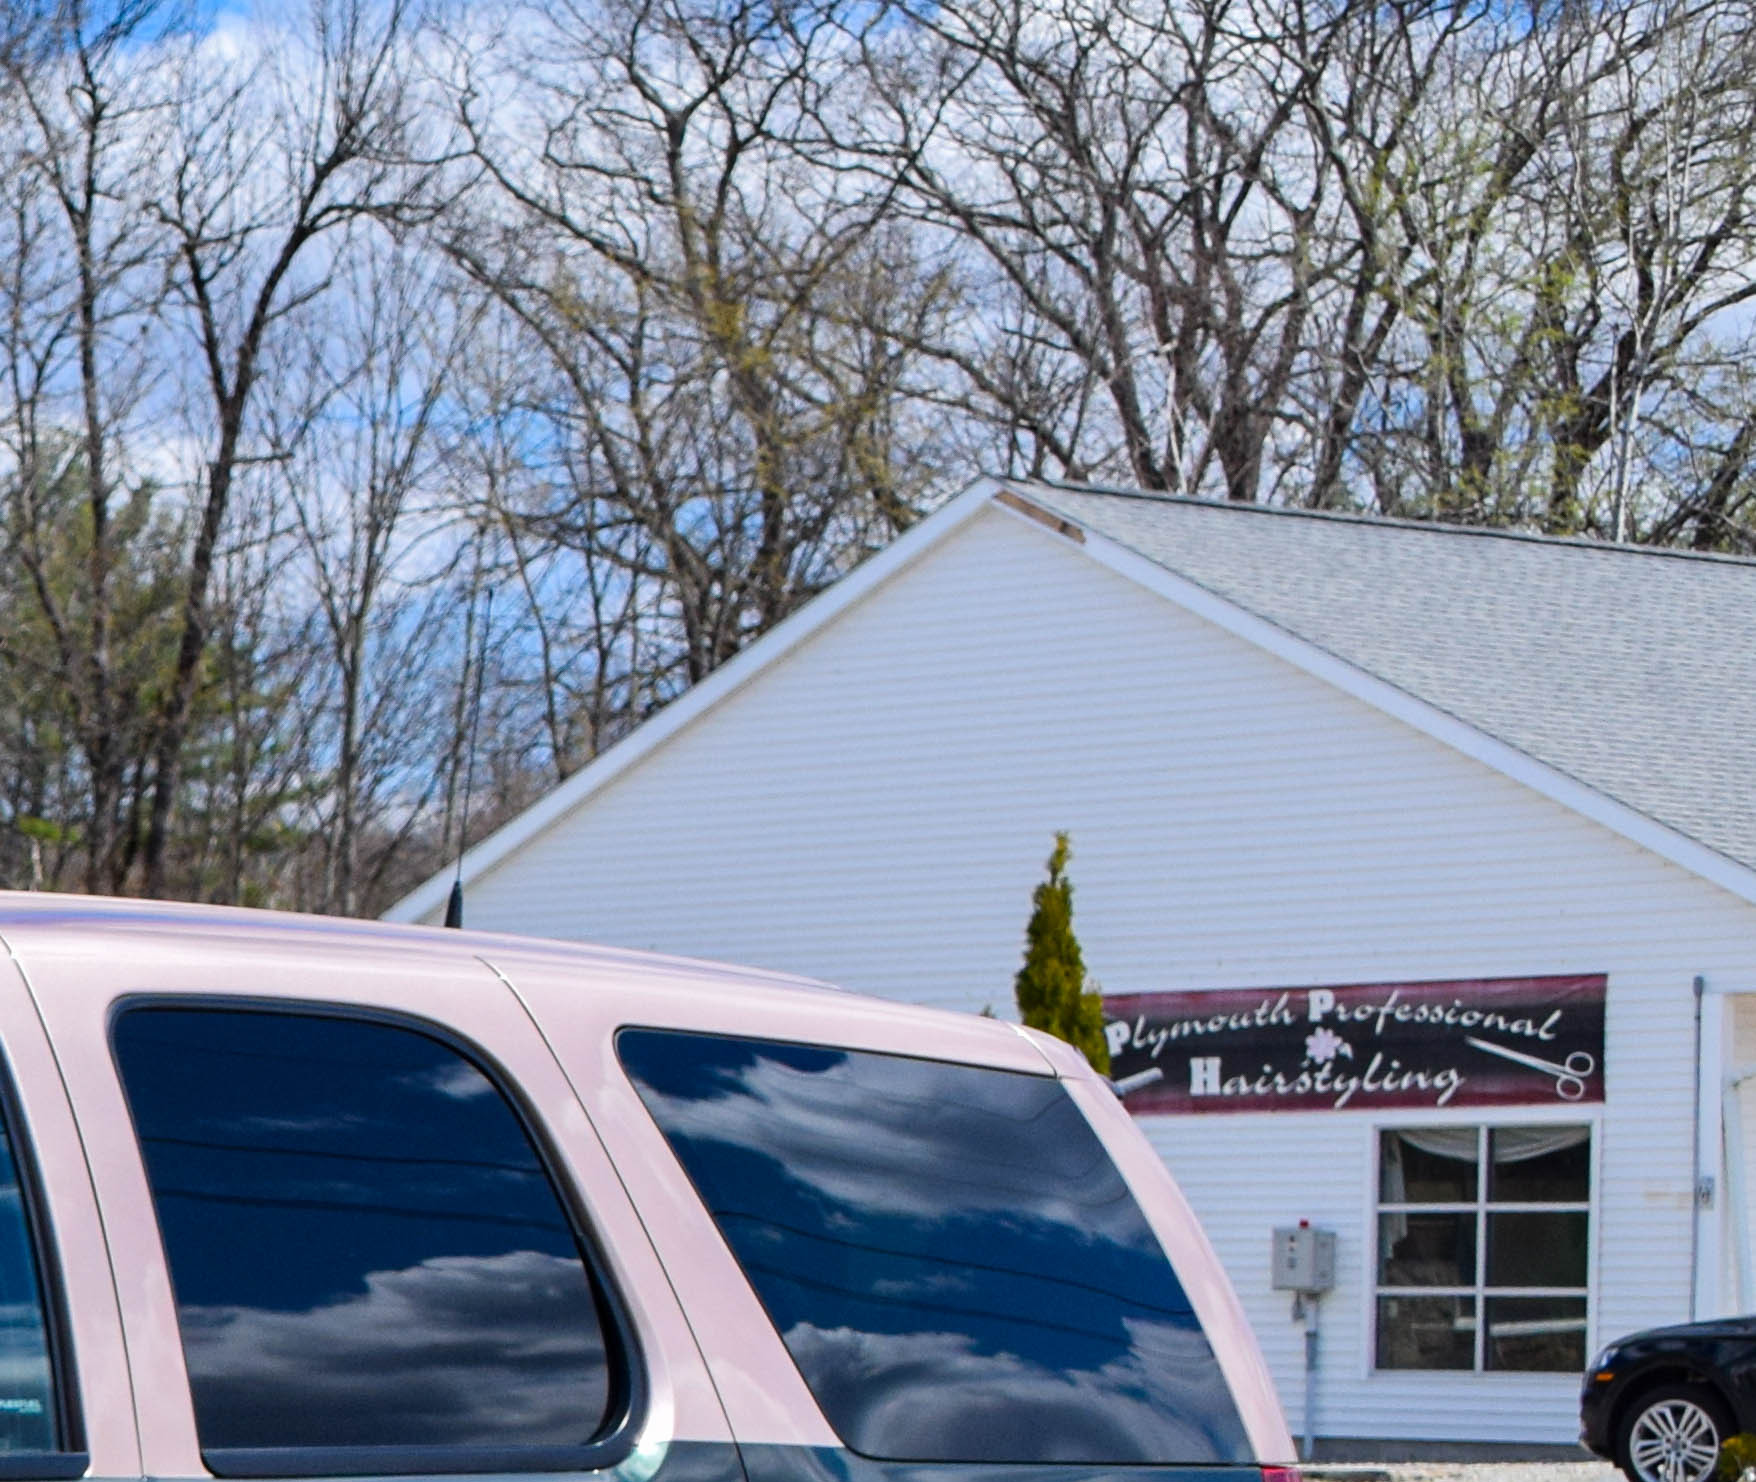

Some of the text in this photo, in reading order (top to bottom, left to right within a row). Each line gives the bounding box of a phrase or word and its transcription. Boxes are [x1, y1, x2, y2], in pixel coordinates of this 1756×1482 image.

[1104, 988, 1564, 1058] Plymouth Professional
[1188, 1051, 1466, 1110] Hairstyling
